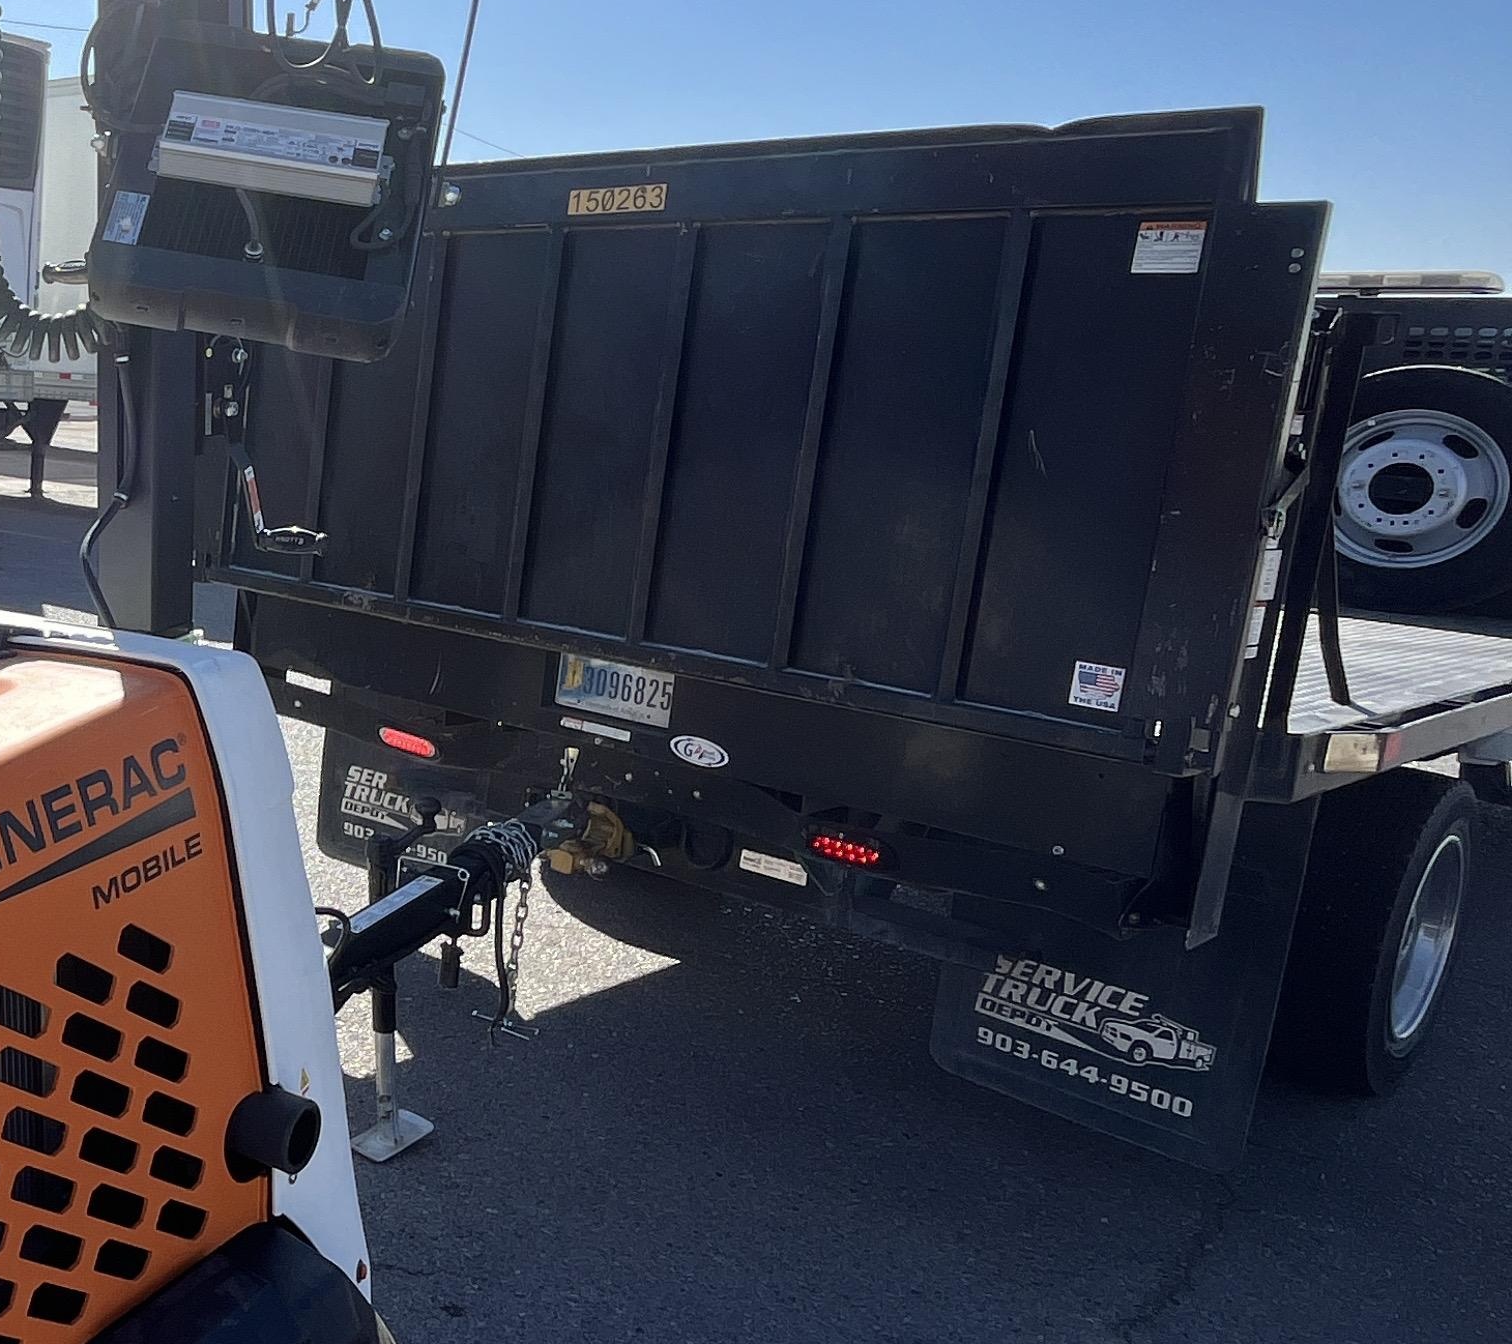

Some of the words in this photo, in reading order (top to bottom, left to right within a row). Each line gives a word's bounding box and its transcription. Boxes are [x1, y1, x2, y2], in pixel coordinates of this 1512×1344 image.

[572, 185, 664, 213] 150263
[1078, 664, 1108, 675] MADE
[1073, 695, 1092, 705] THE
[1095, 698, 1116, 709] USA
[344, 781, 411, 814] TRUCK
[91, 832, 204, 910] MOBILE
[981, 972, 1103, 1030] TRUCK
[995, 955, 1150, 1017] SERVICE
[977, 995, 1059, 1033] DEPOT
[976, 1026, 1194, 1118] 903-644-9500
